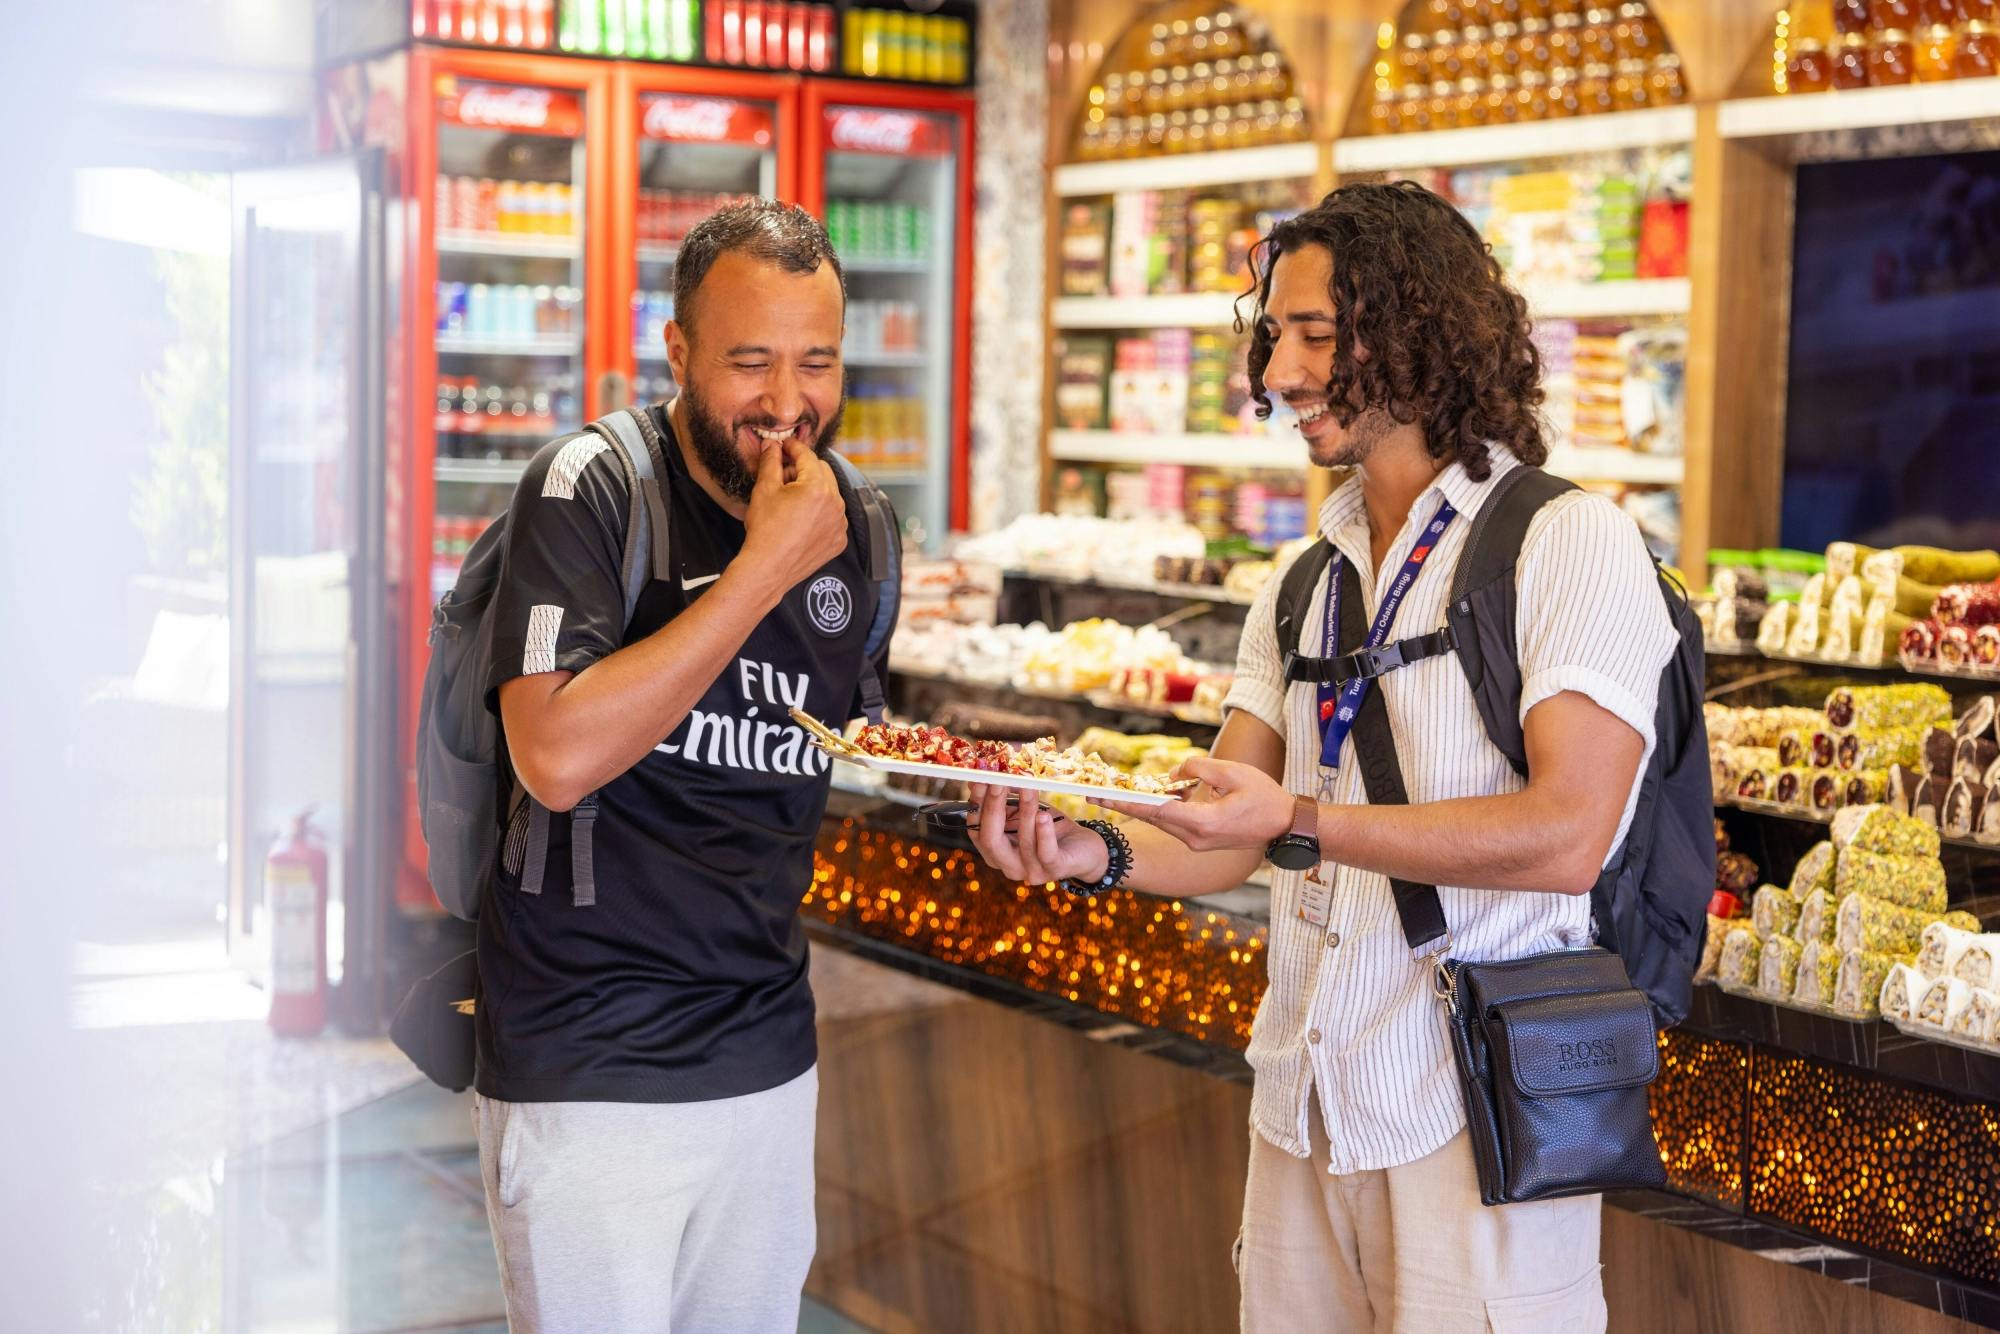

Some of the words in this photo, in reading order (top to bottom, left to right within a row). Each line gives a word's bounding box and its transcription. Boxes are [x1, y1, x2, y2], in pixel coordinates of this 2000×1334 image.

[813, 580, 842, 594] PARIS
[739, 658, 809, 711] Fly
[1560, 1038, 1616, 1062] BOSS
[1560, 1060, 1588, 1071] HUGO
